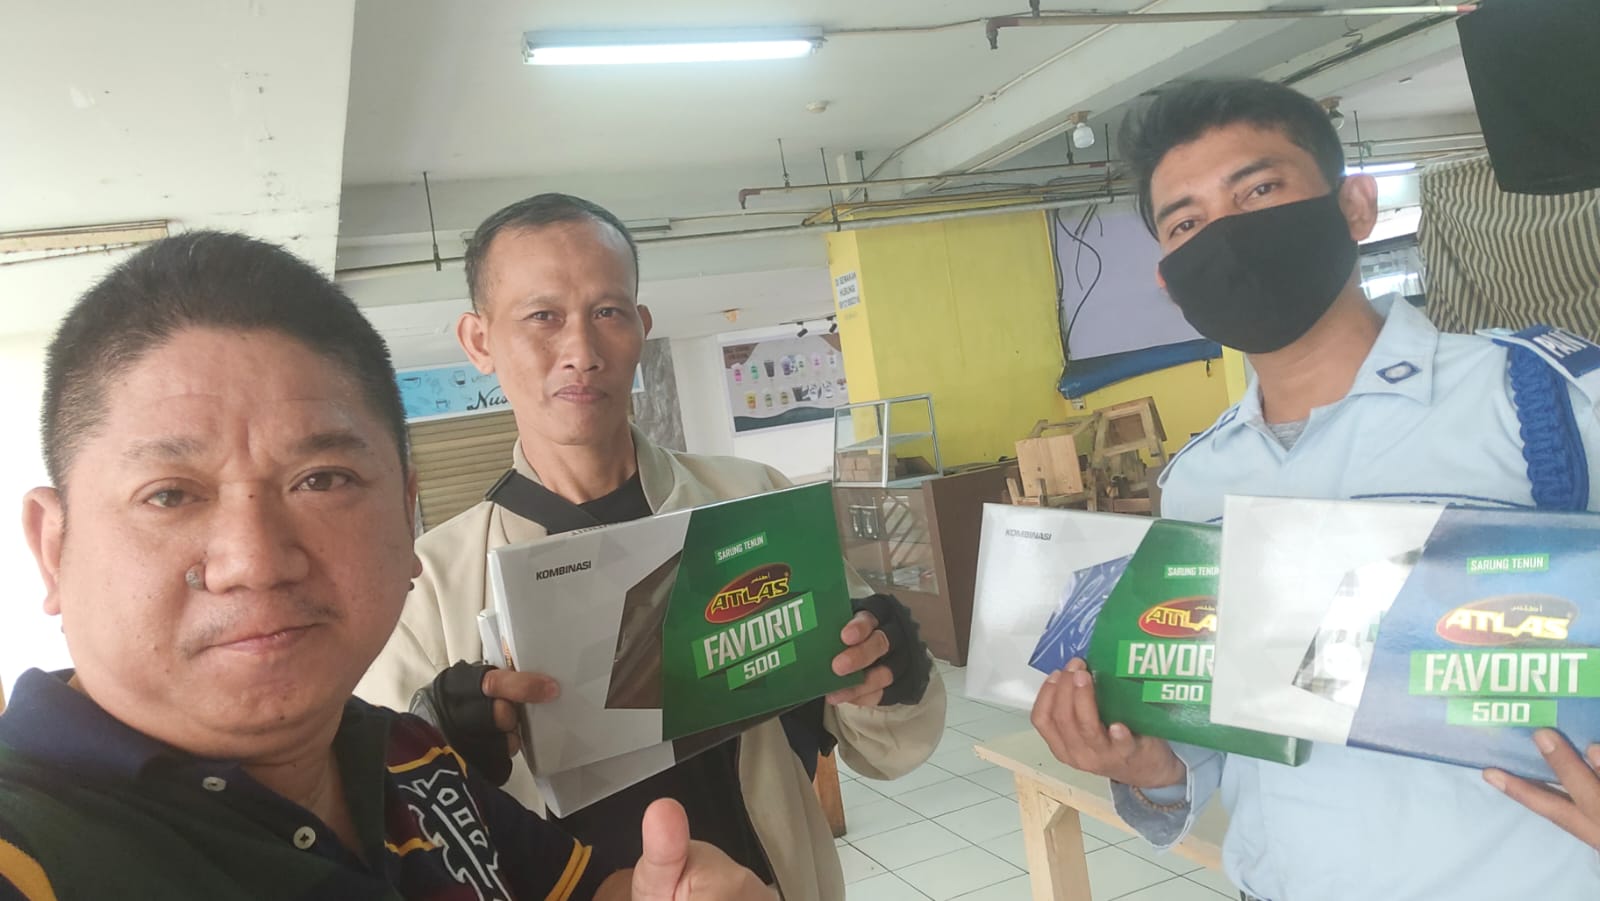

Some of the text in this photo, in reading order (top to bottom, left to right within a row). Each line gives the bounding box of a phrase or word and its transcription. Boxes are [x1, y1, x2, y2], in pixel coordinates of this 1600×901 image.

[1005, 529, 1052, 541] KOMBINASI
[717, 535, 764, 561] SARUNG TENUN
[536, 560, 592, 581] KOMBINASI
[1167, 566, 1196, 577] SARUNG
[1471, 556, 1544, 572] SARUNG TENUN
[711, 577, 790, 615] ATLAS
[703, 598, 804, 671] FAVORIT
[1445, 607, 1571, 641] ATLAS
[743, 650, 781, 681] 500
[1424, 652, 1588, 694] FAVORIT
[1161, 683, 1204, 702] 500
[1471, 701, 1531, 723] 500
